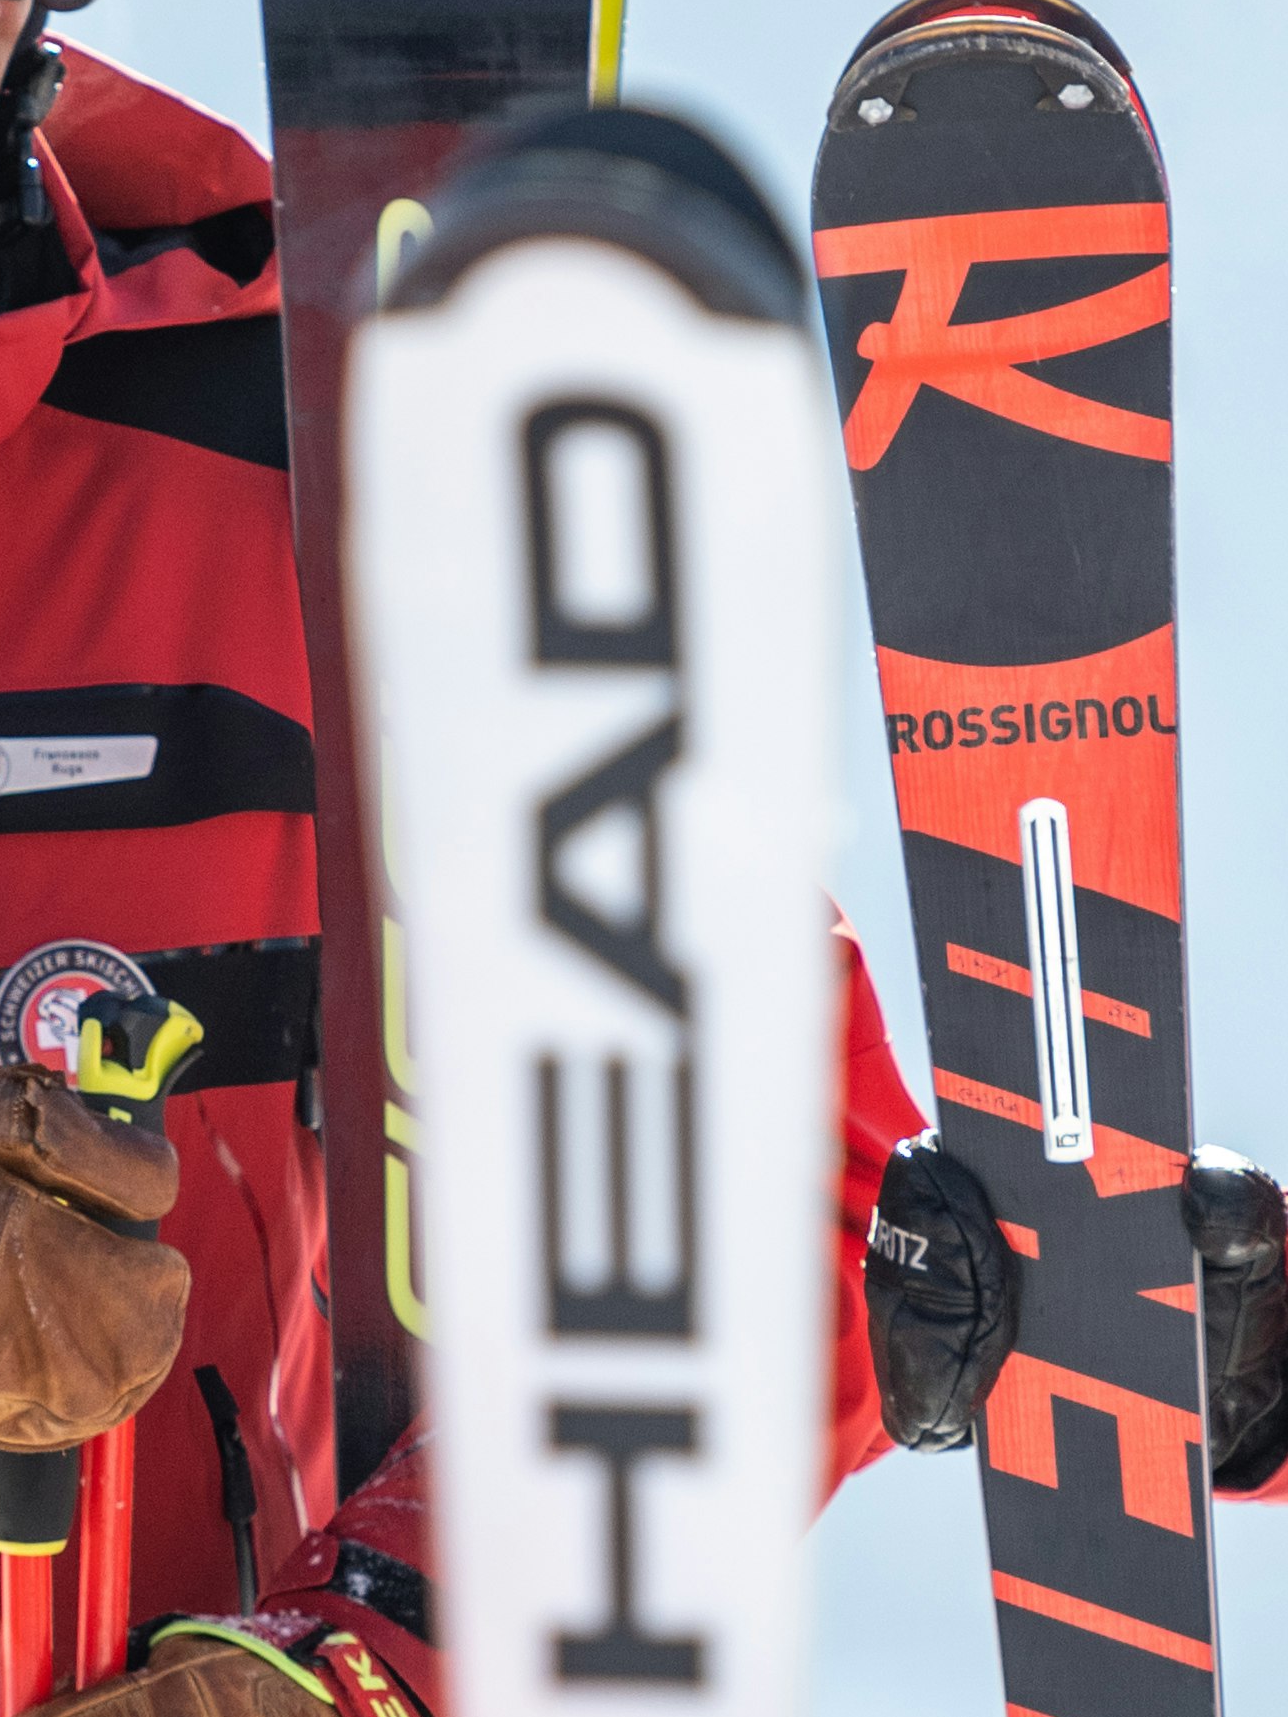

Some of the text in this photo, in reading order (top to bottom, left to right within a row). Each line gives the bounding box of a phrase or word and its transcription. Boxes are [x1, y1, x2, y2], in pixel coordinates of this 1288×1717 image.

[886, 694, 1177, 755] ROSSIGNOL
[0, 951, 69, 1043] SCHWEIZER
[523, 398, 708, 1688] HEAD
